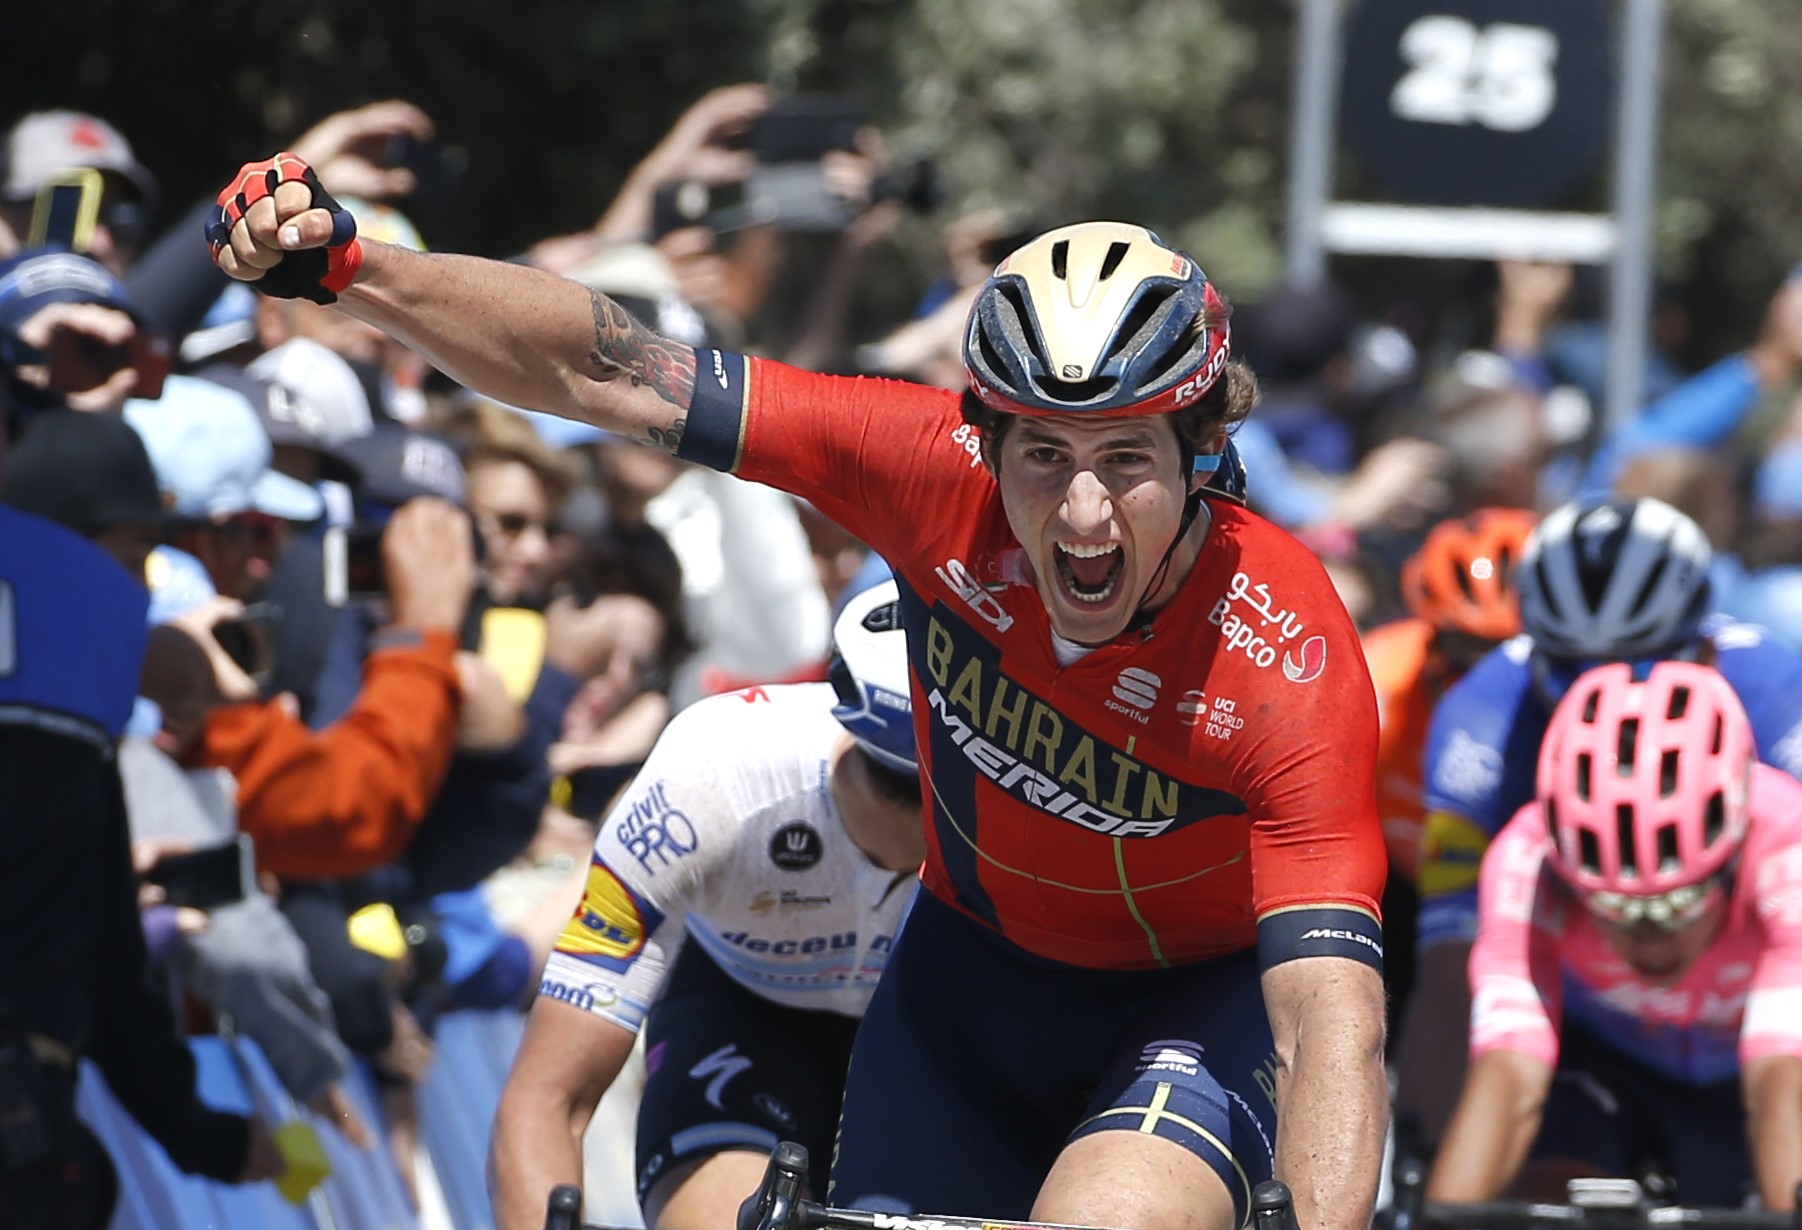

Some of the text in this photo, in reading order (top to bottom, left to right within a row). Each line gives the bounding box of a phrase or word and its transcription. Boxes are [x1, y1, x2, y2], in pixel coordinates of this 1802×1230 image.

[1389, 14, 1558, 132] 25
[934, 559, 1014, 634] SIDI
[1208, 597, 1276, 668] Bapco
[926, 616, 1179, 819] BAHRAIN
[1104, 699, 1150, 725] sportful
[1205, 722, 1232, 741] TOUR
[1210, 709, 1244, 730] WORLD
[1214, 697, 1236, 713] UCI
[927, 688, 1175, 838] MERIDA
[617, 782, 670, 844] crivit
[627, 808, 697, 876] PRO
